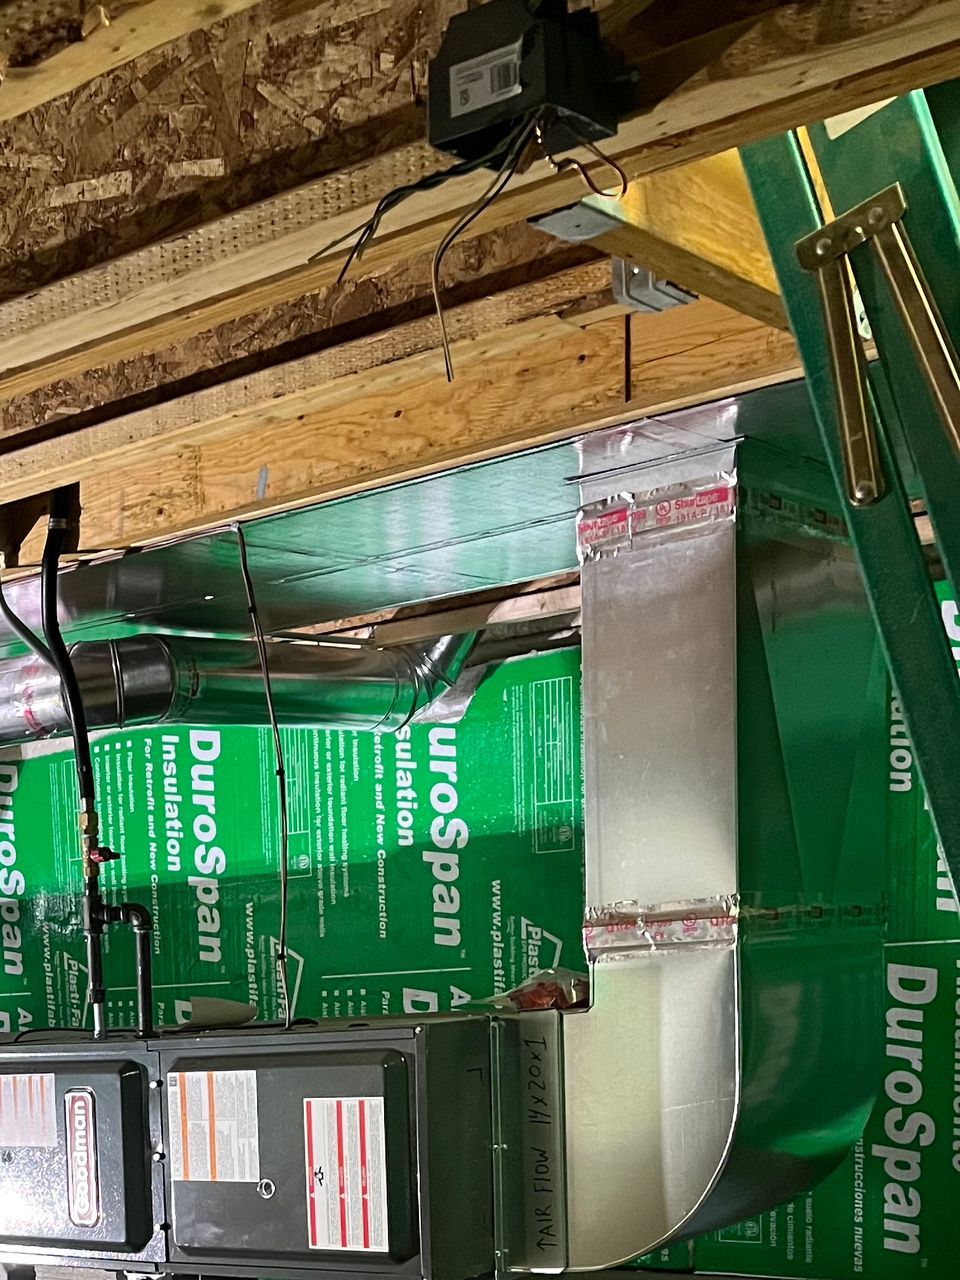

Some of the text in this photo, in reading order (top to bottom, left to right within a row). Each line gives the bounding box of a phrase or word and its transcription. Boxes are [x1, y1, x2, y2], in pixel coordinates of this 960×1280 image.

[144, 738, 162, 955] For Retrofit and New Construction
[161, 734, 184, 872] Insulation
[187, 729, 226, 964] DuroSpan
[373, 731, 387, 938] etrofit and New Construction
[395, 728, 417, 846] sulation
[422, 726, 469, 946] uroSpan
[42, 922, 55, 1027] www.plastifab
[245, 902, 257, 1007] www.plastifa
[73, 1101, 90, 1214] Goodman
[871, 963, 938, 1254] DuroSpan
[534, 1204, 556, 1236] AIR
[786, 1215, 795, 1260] cimientos
[805, 1225, 813, 1263] radiante
[854, 1138, 865, 1272] nstrucciones nuevas
